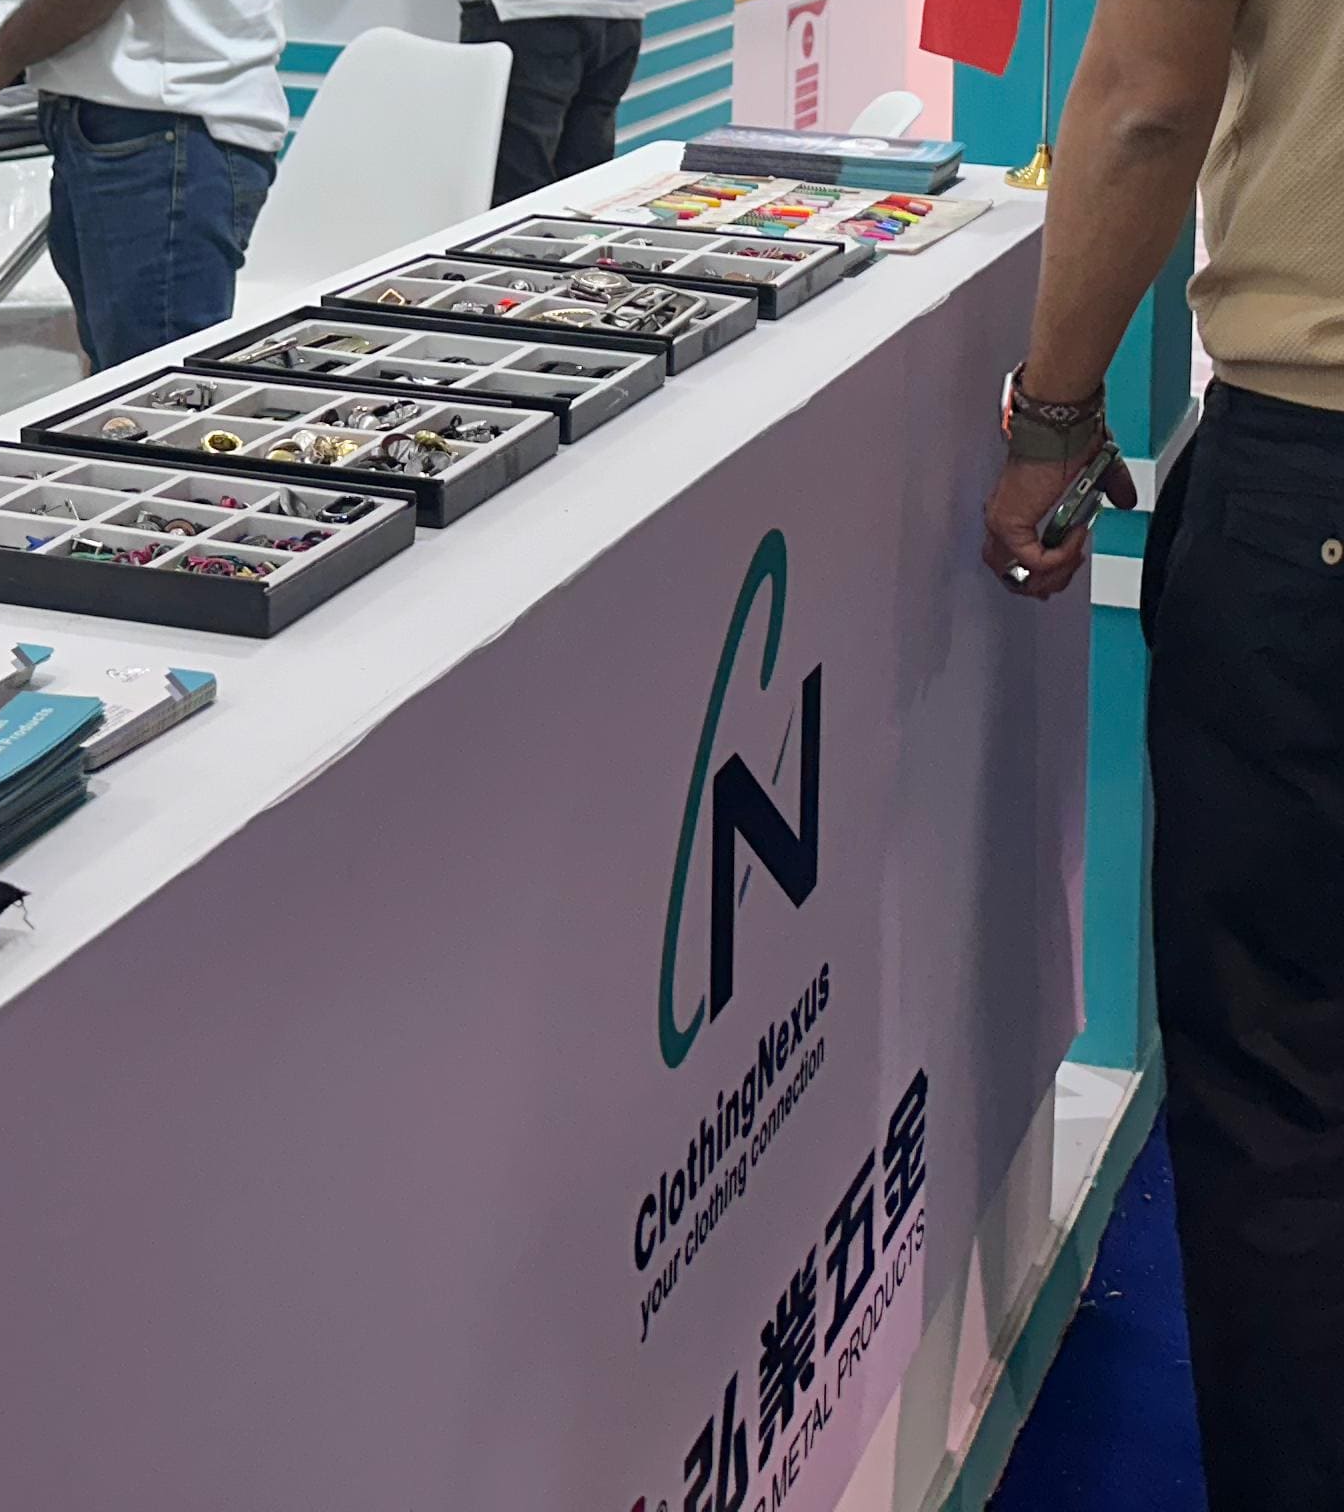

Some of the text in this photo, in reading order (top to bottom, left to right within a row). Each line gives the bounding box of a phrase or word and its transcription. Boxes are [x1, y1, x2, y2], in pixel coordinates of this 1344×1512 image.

[0, 708, 54, 745] Products
[634, 962, 830, 1271] ClothingNexus
[641, 1036, 824, 1343] your clothing connection
[771, 1207, 925, 1511] METAL PRODUCTS
